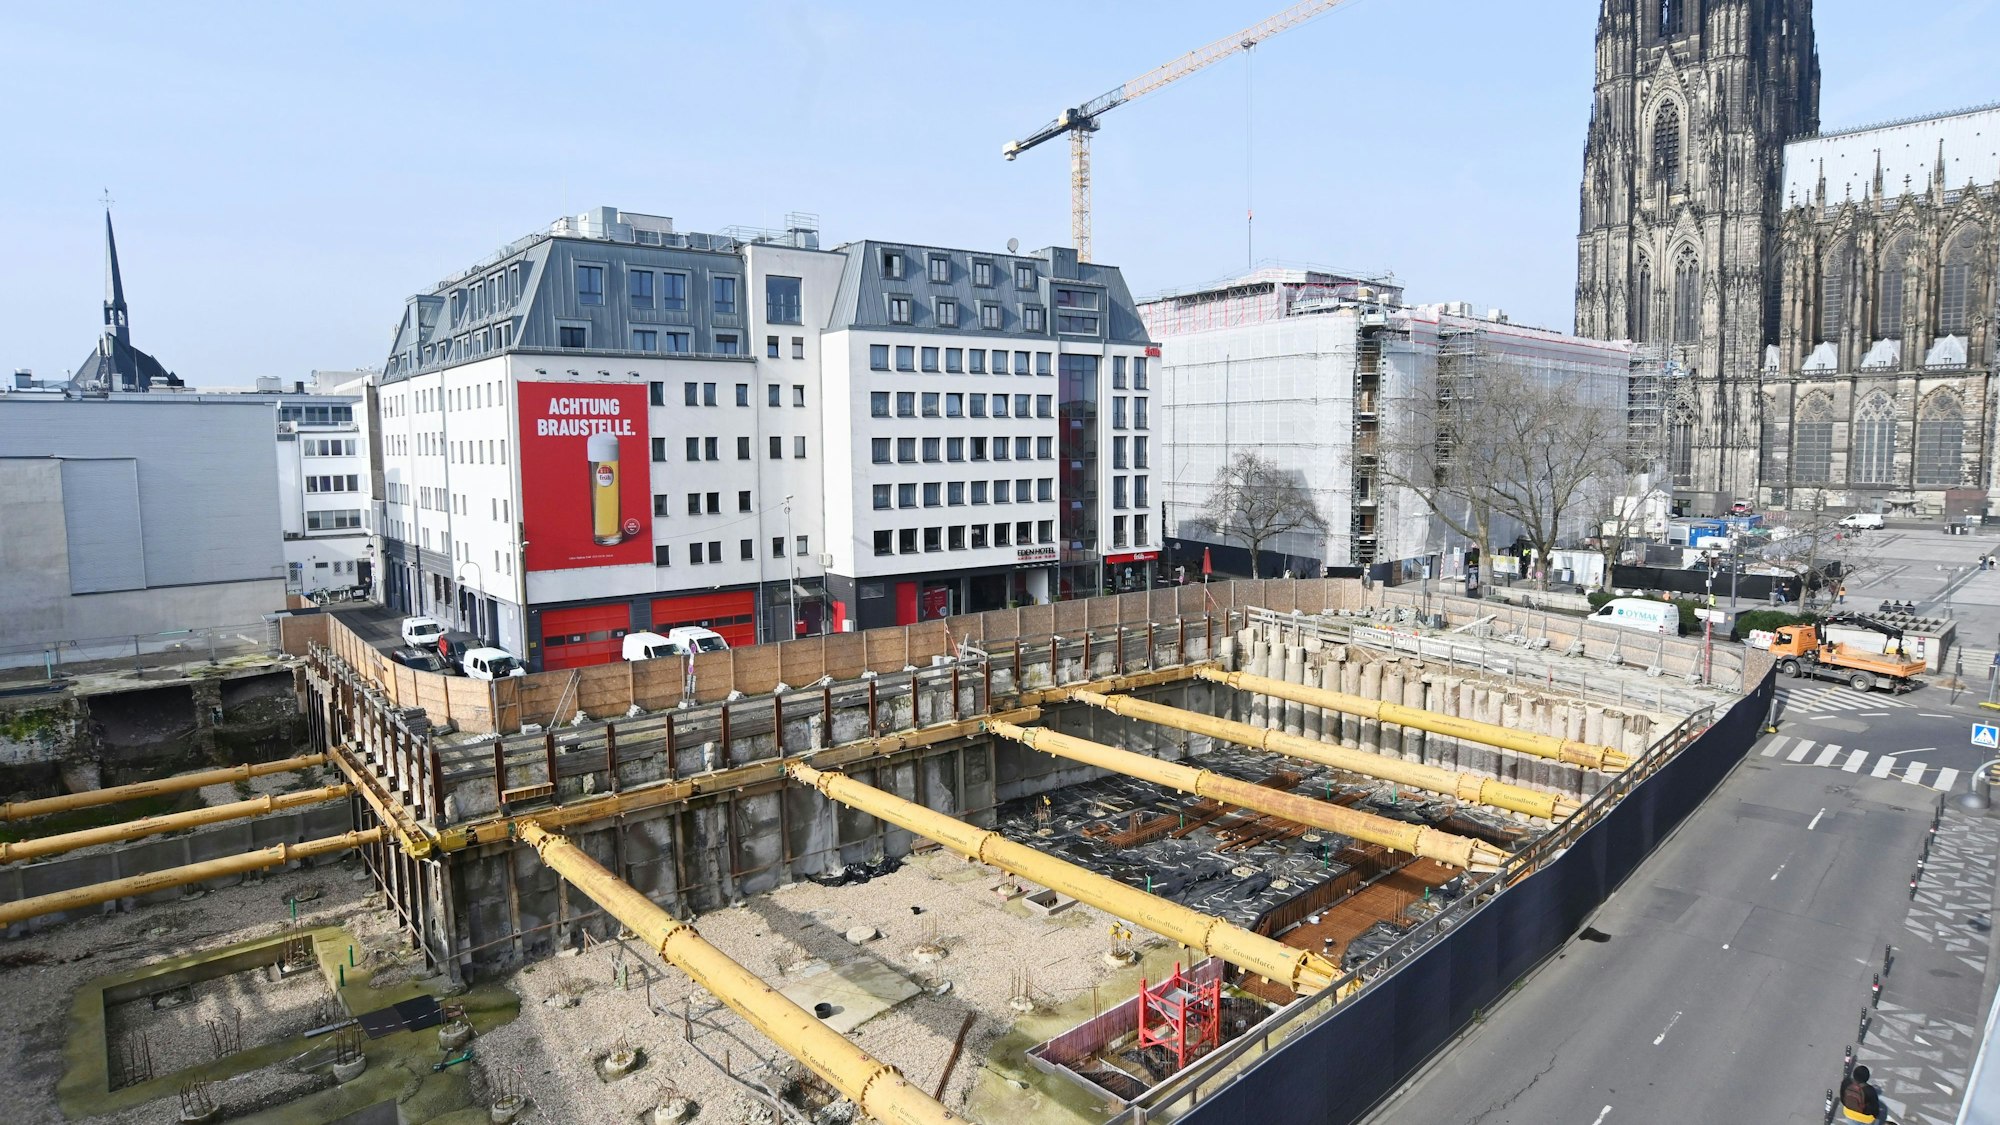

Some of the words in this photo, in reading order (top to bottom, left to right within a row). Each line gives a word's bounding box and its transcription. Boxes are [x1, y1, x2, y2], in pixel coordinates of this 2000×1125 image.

[549, 398, 620, 415] ACHTUNG
[537, 419, 636, 436] BRAUSTELLE.
[1035, 546, 1056, 555] HOTEL
[1625, 608, 1658, 622] OYMAK
[1503, 793, 1539, 808] Groundforce
[1146, 914, 1184, 934] Groundforce
[1232, 948, 1276, 971] Groundforce
[809, 1054, 845, 1085] Groundforce
